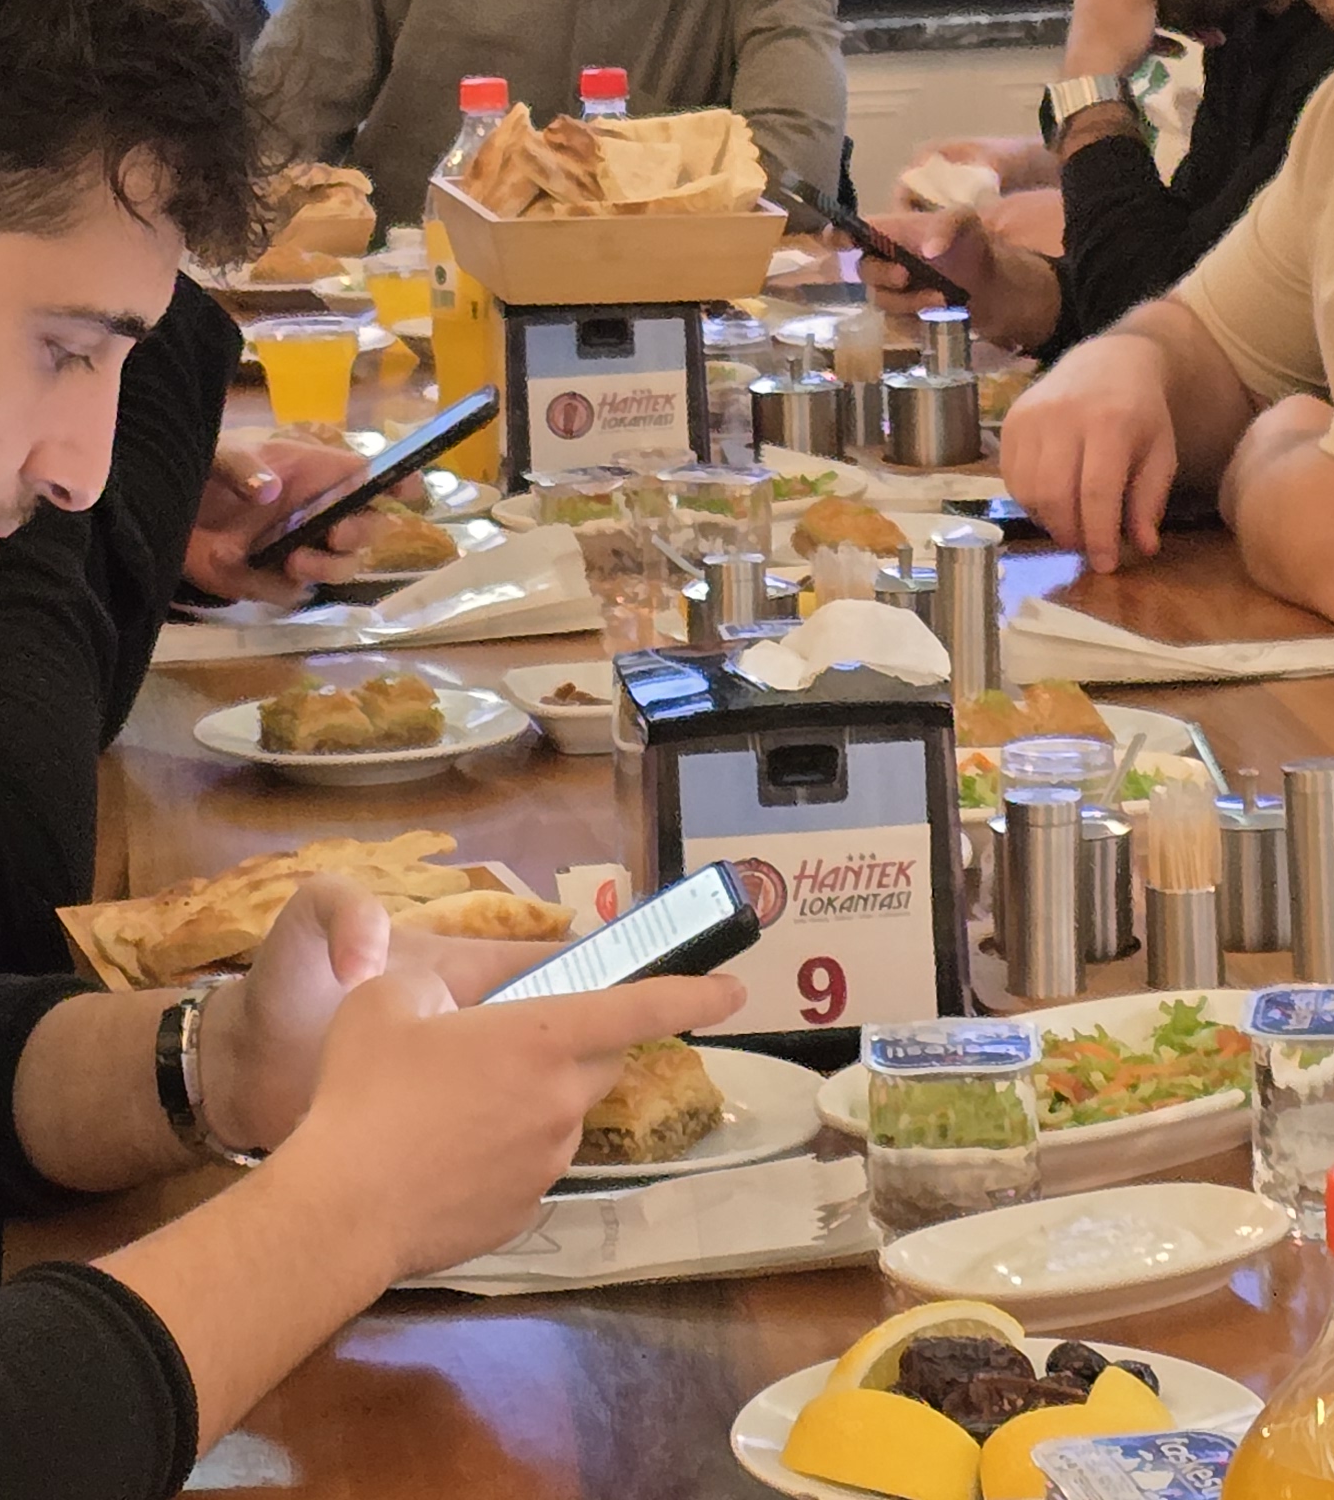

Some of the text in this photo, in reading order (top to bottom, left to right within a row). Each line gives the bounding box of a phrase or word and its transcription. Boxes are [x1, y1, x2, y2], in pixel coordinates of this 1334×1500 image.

[597, 391, 676, 421] HANTEK
[793, 858, 917, 902] HANTEK
[799, 891, 912, 917] LOKANTASI
[797, 956, 847, 1025] 9
